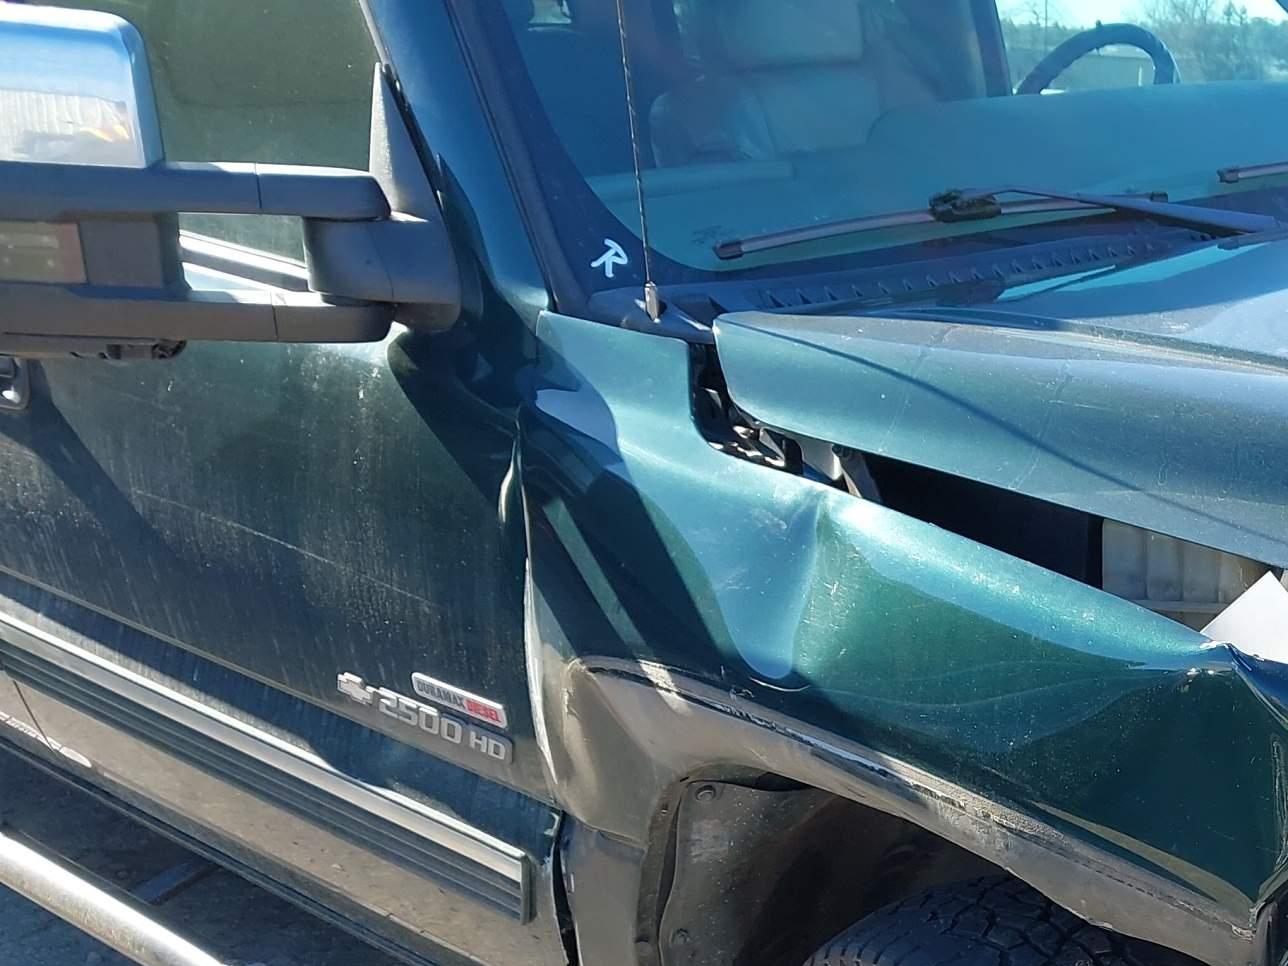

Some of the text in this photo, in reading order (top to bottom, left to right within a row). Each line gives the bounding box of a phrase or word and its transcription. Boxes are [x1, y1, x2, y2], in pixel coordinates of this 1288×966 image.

[590, 238, 628, 278] R
[417, 680, 502, 723] DURAMAX DIESEL
[378, 690, 506, 760] 2500 HD
